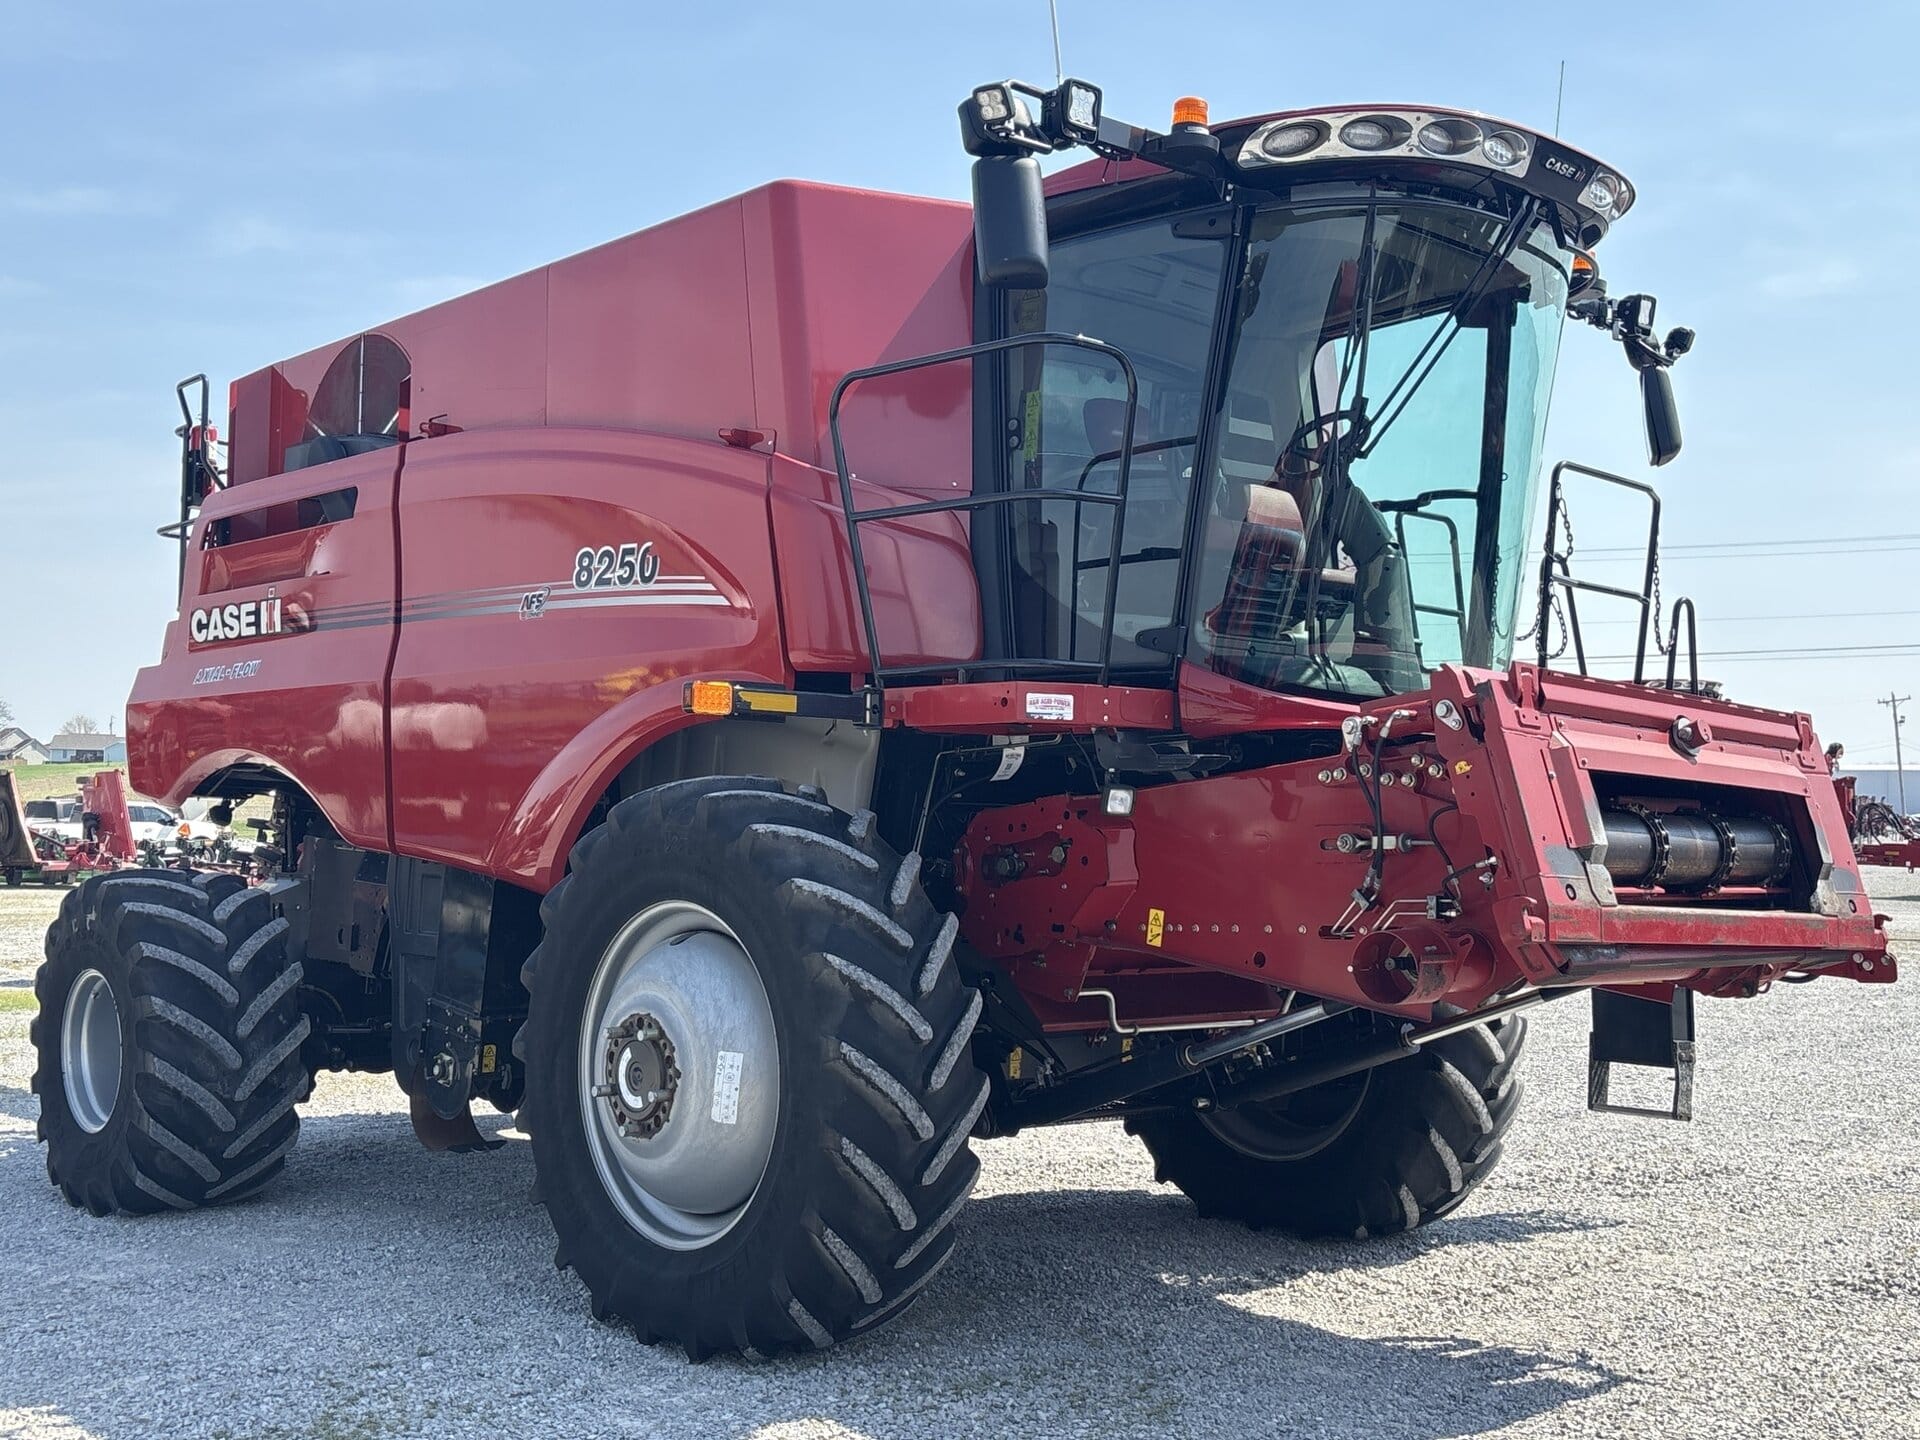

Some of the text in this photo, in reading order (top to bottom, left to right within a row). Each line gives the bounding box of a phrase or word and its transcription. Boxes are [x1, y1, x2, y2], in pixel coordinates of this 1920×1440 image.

[1545, 157, 1576, 178] CASE
[572, 541, 660, 591] 8250
[518, 590, 546, 612] AFS
[190, 601, 257, 643] CASE
[192, 659, 262, 685] AXIAL-FLOW
